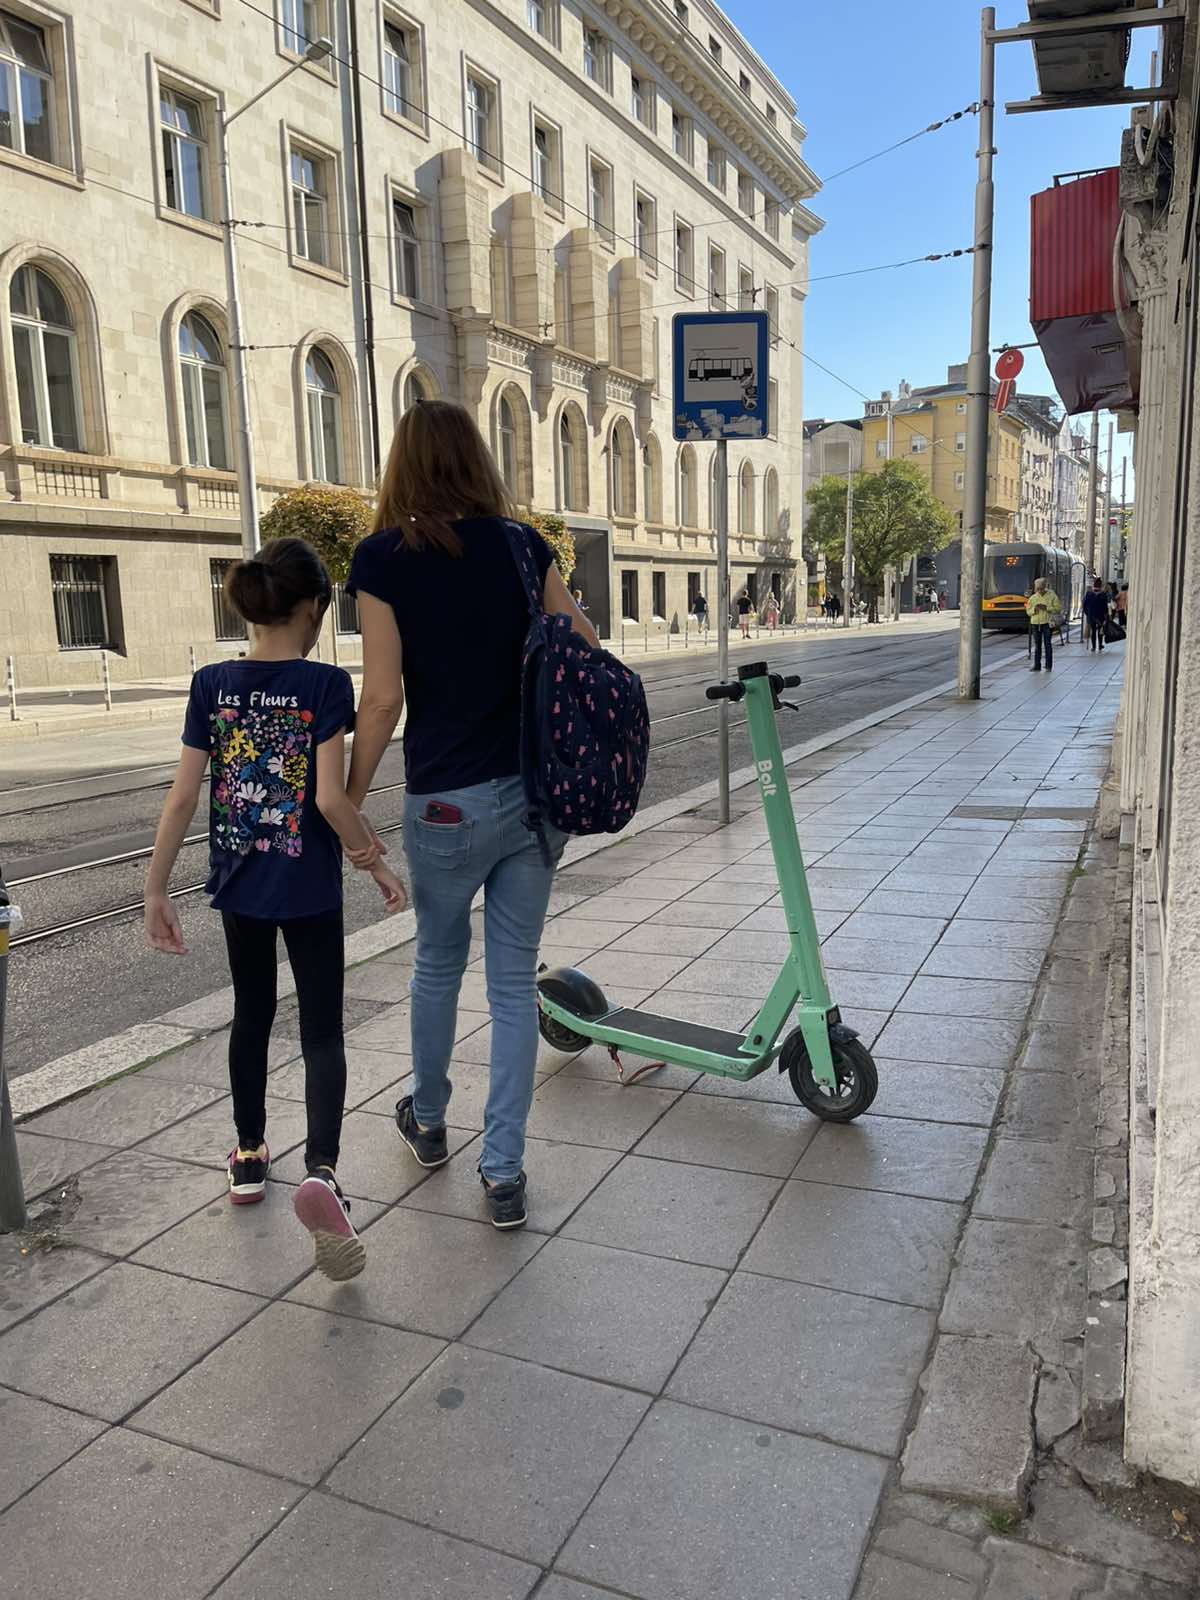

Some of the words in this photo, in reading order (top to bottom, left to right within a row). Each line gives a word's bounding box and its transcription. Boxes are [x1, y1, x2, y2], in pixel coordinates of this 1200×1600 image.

[217, 689, 241, 706] Les
[249, 691, 298, 707] Fleurs
[758, 759, 777, 797] Bolt
